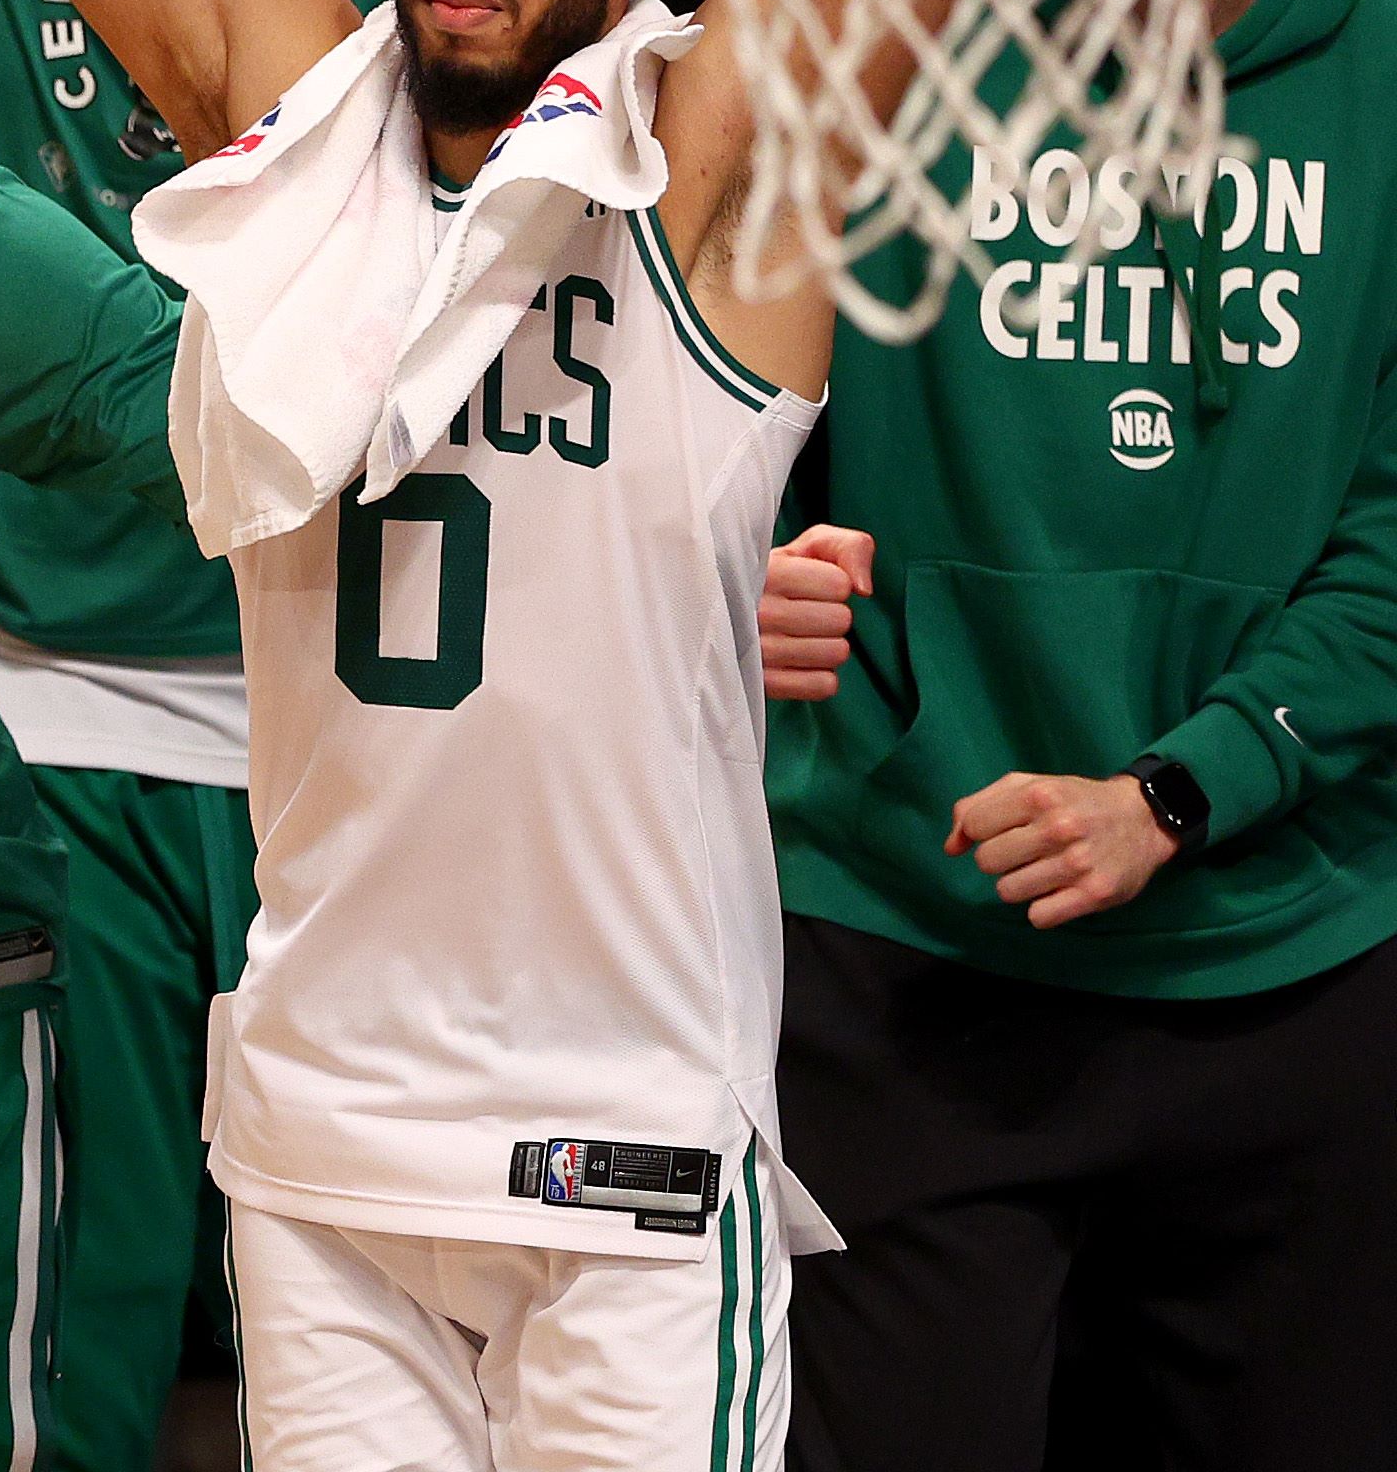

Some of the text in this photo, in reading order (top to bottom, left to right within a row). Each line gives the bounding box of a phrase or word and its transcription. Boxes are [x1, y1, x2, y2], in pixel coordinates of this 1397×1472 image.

[980, 259, 1301, 369] CELTICS
[1112, 411, 1175, 448] NBA
[334, 472, 491, 711] 0
[590, 1160, 606, 1172] 48
